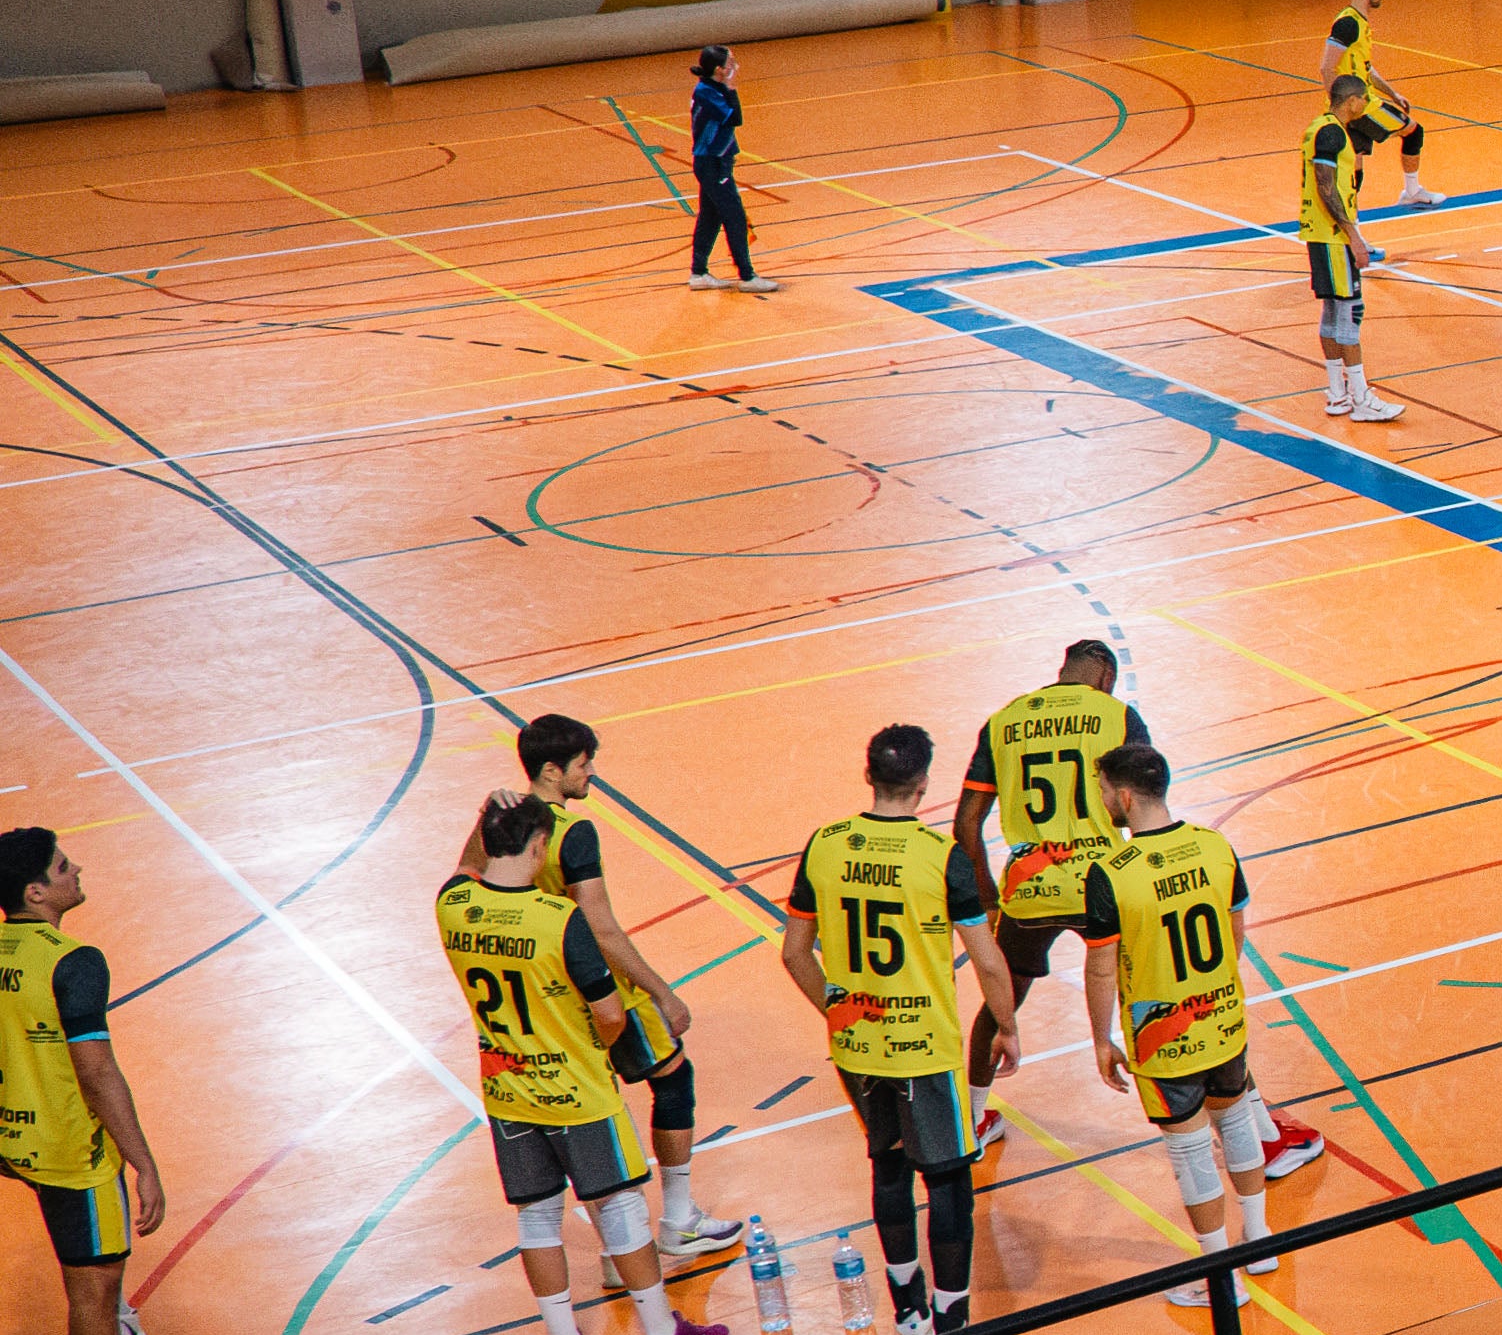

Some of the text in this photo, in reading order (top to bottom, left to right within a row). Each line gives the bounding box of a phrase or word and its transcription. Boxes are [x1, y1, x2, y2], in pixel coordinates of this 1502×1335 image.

[1003, 714, 1102, 745] DE CARVALHO
[1020, 748, 1090, 825] 57
[840, 860, 903, 888] JARQUE
[1153, 866, 1211, 902] HUERTA
[840, 896, 906, 977] 15
[1160, 902, 1225, 984] 10
[466, 966, 535, 1036] 21
[853, 993, 932, 1010] HYUNDAI
[899, 1012, 921, 1024] Car
[889, 1041, 928, 1054] TIPSA
